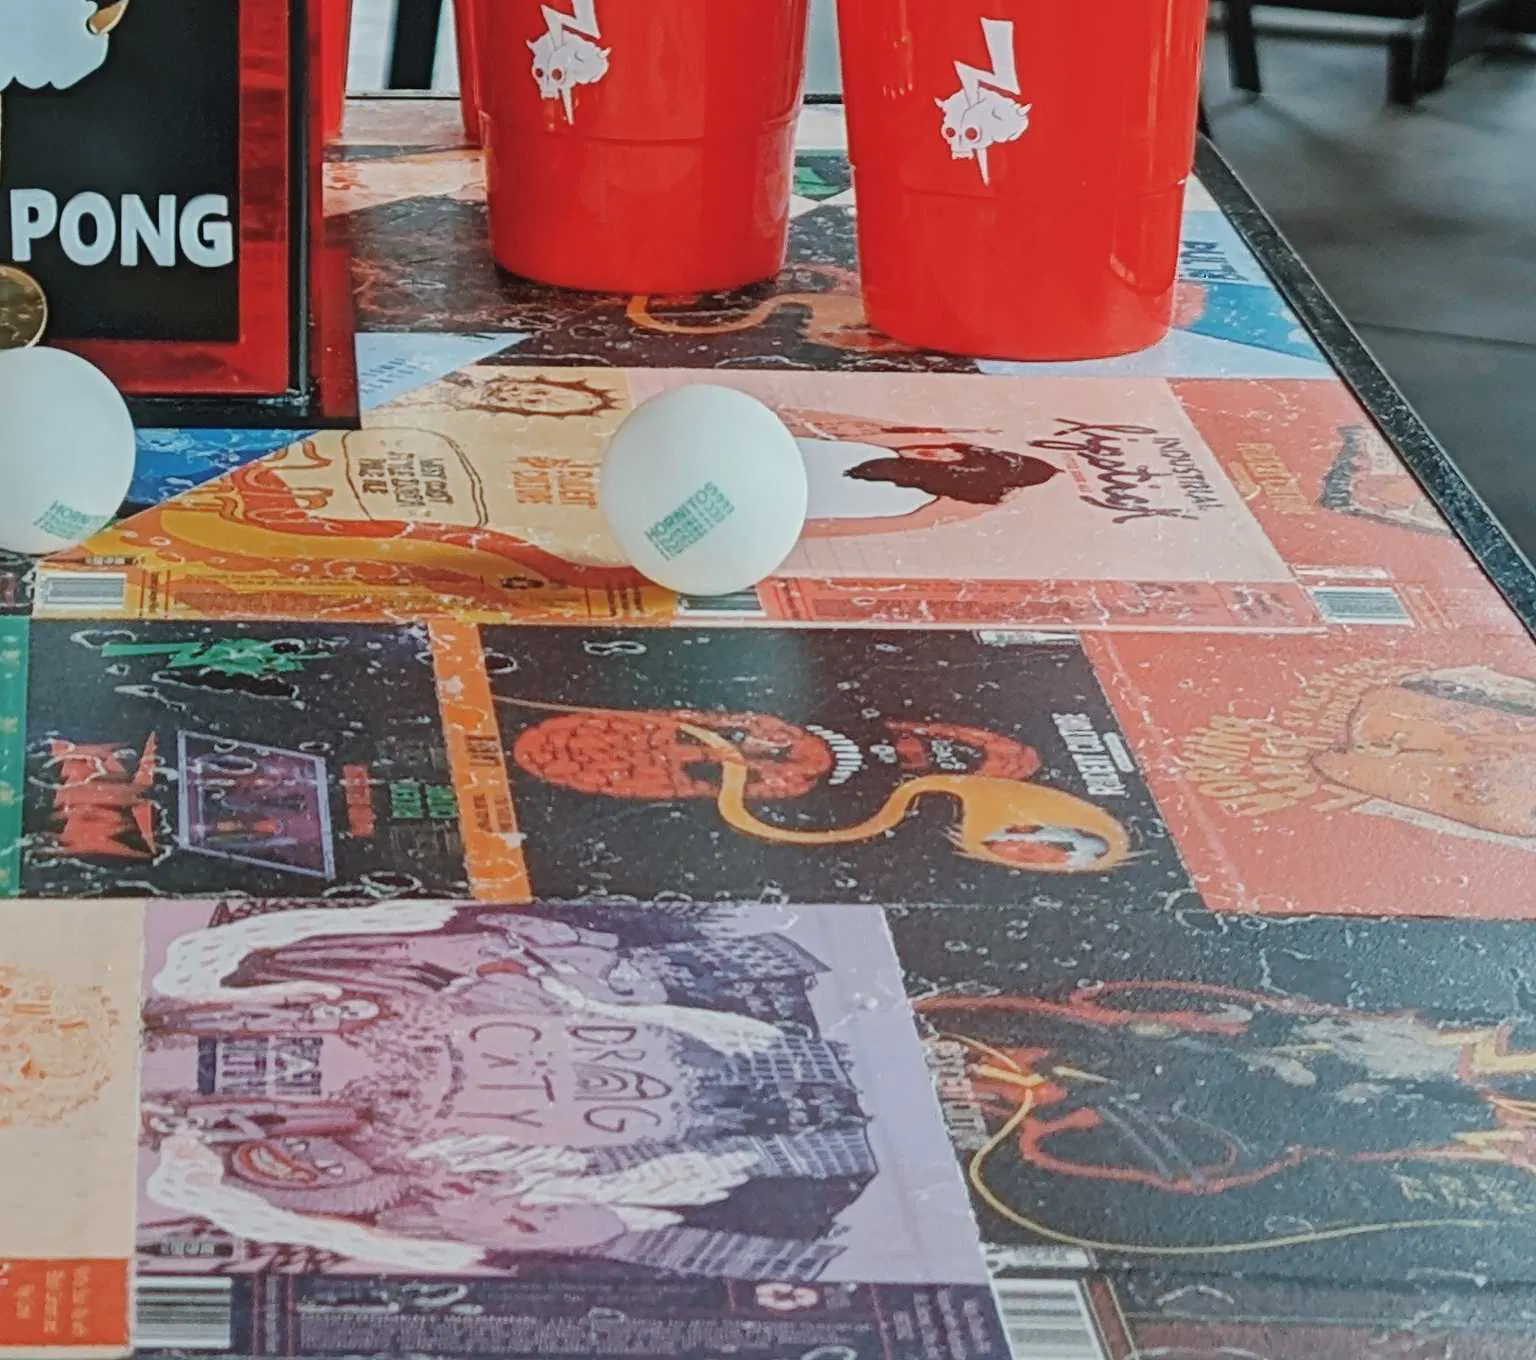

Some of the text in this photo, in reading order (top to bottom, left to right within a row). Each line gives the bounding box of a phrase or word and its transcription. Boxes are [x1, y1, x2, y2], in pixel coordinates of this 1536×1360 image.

[11, 187, 235, 268] PONG
[1152, 437, 1224, 510] INDUSTRIAL
[644, 480, 727, 551] HORNITOS
